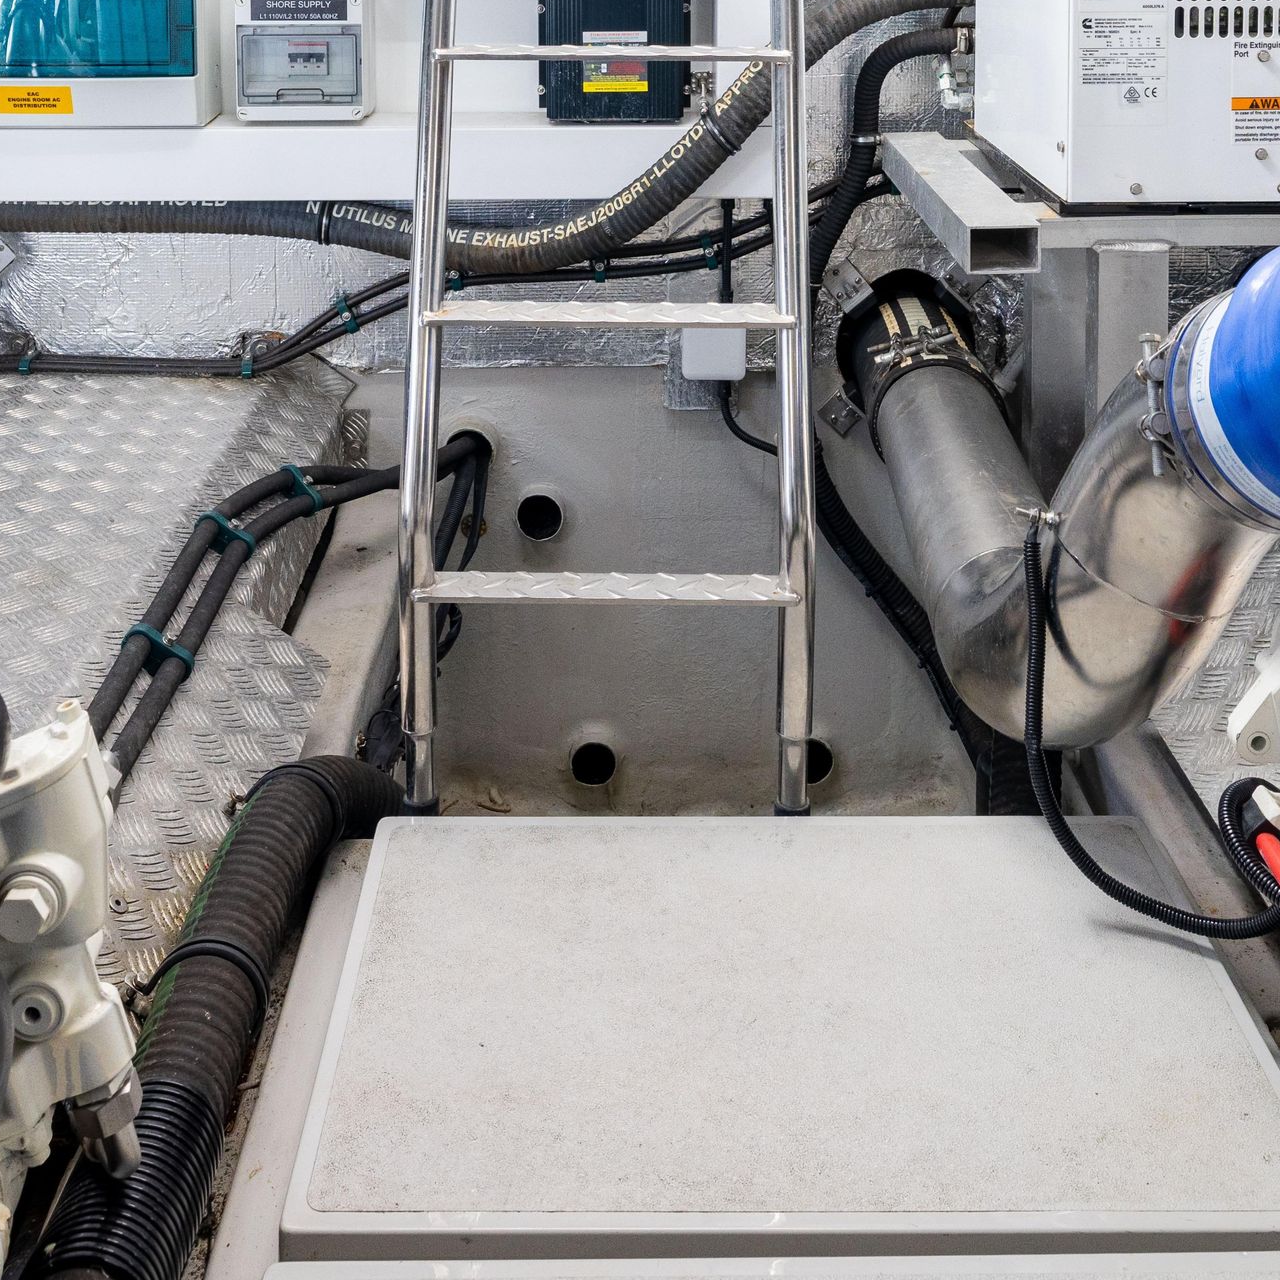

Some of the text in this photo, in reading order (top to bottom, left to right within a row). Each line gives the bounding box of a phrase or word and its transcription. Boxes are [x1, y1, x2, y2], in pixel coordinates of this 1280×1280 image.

[266, 0, 332, 9] SHORE SUPPLY
[1234, 41, 1248, 49] Fire
[1234, 50, 1249, 58] Port
[305, 200, 396, 229] NUTILUS
[399, 219, 468, 244] MNE
[714, 60, 763, 117] APPRO
